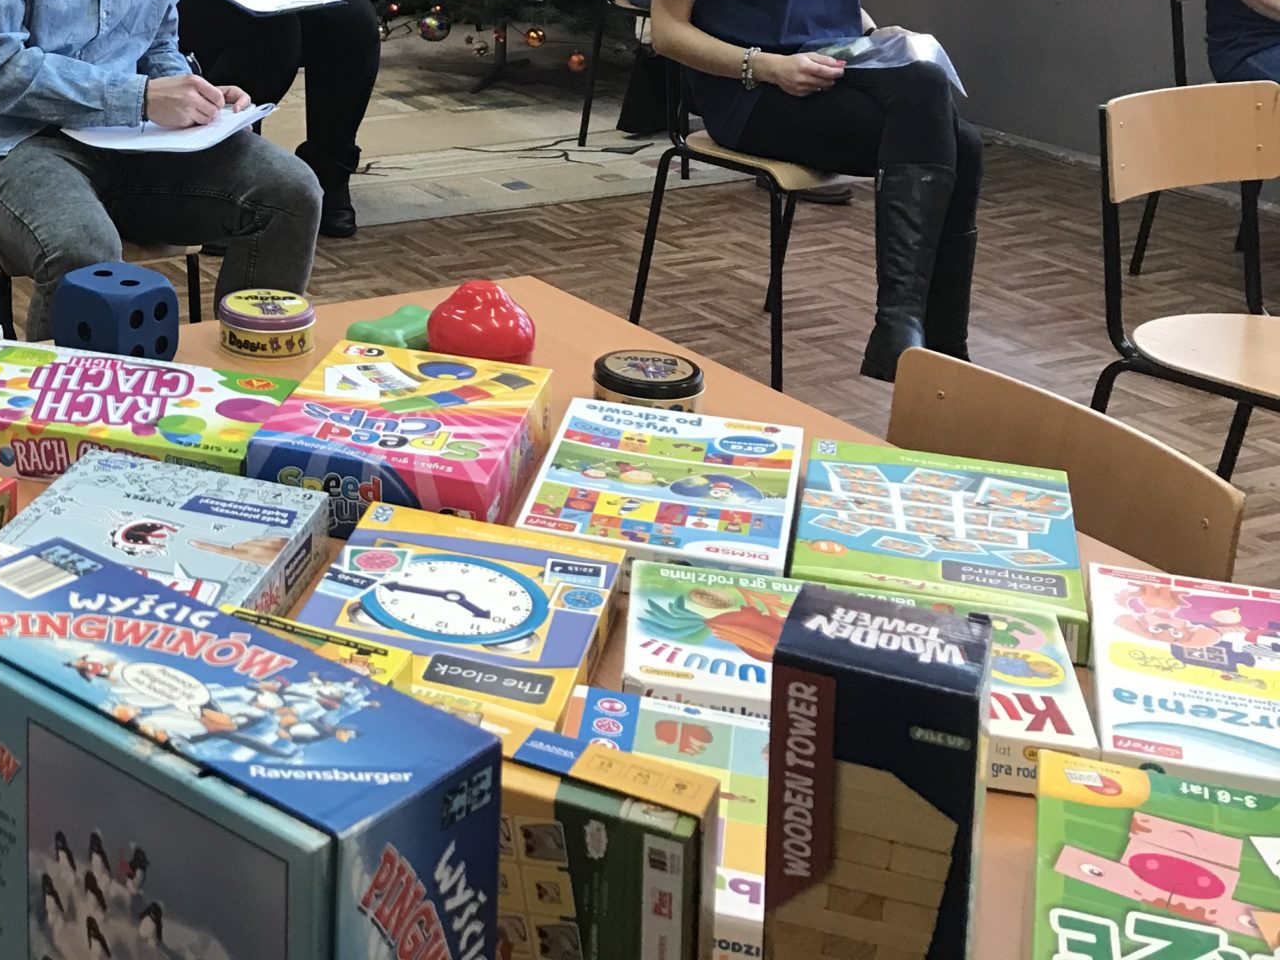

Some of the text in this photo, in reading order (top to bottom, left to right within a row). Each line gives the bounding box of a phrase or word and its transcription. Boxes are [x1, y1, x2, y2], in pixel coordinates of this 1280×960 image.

[66, 357, 125, 371] LIGHT
[32, 366, 190, 397] CIACH!
[36, 391, 164, 424] RACH
[586, 403, 704, 428] po zdrowie
[301, 402, 443, 437] Cups
[602, 415, 679, 436] Wyścig
[315, 421, 488, 461] Speed
[730, 444, 767, 454] Gra
[12, 439, 70, 473] RACH
[719, 547, 770, 561] DKMS
[659, 567, 736, 588] rodzinna
[741, 576, 770, 591] gra
[961, 574, 1058, 596] Look and
[962, 564, 1056, 585] compare
[491, 615, 508, 624] 10
[830, 605, 941, 636] TOWER
[804, 614, 966, 664] WOODEN
[434, 661, 546, 697] The clock
[995, 743, 1012, 756] lat
[1122, 738, 1161, 754] Trefl
[250, 765, 414, 787] Ravensburger
[783, 681, 819, 878] WOODEN TOWER
[991, 762, 1037, 779] gra rod
[1179, 781, 1258, 808] 3-6 lat
